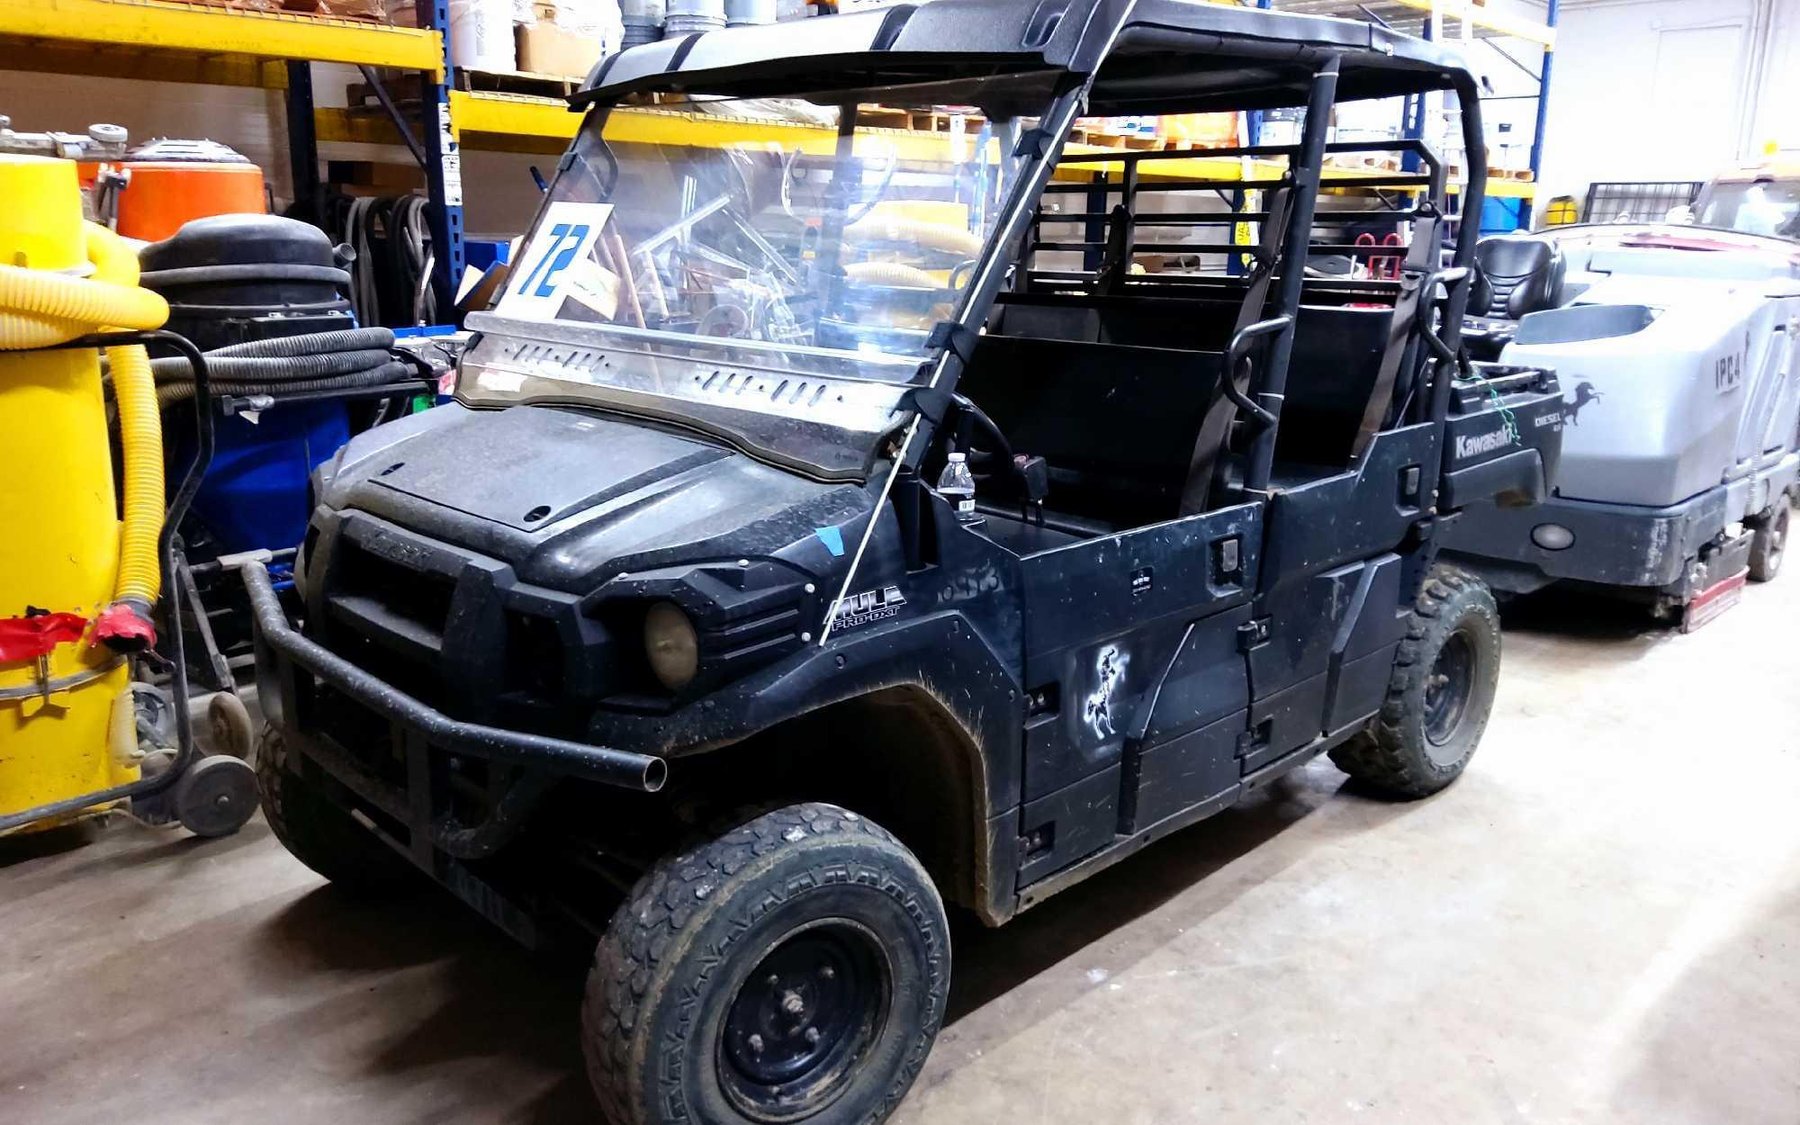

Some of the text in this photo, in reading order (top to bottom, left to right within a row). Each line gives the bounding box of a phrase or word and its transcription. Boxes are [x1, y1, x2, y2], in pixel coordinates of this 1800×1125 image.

[518, 223, 590, 298] 72
[1535, 412, 1561, 427] DIESEL
[1455, 424, 1513, 459] Kawasaki
[822, 585, 907, 624] MULE
